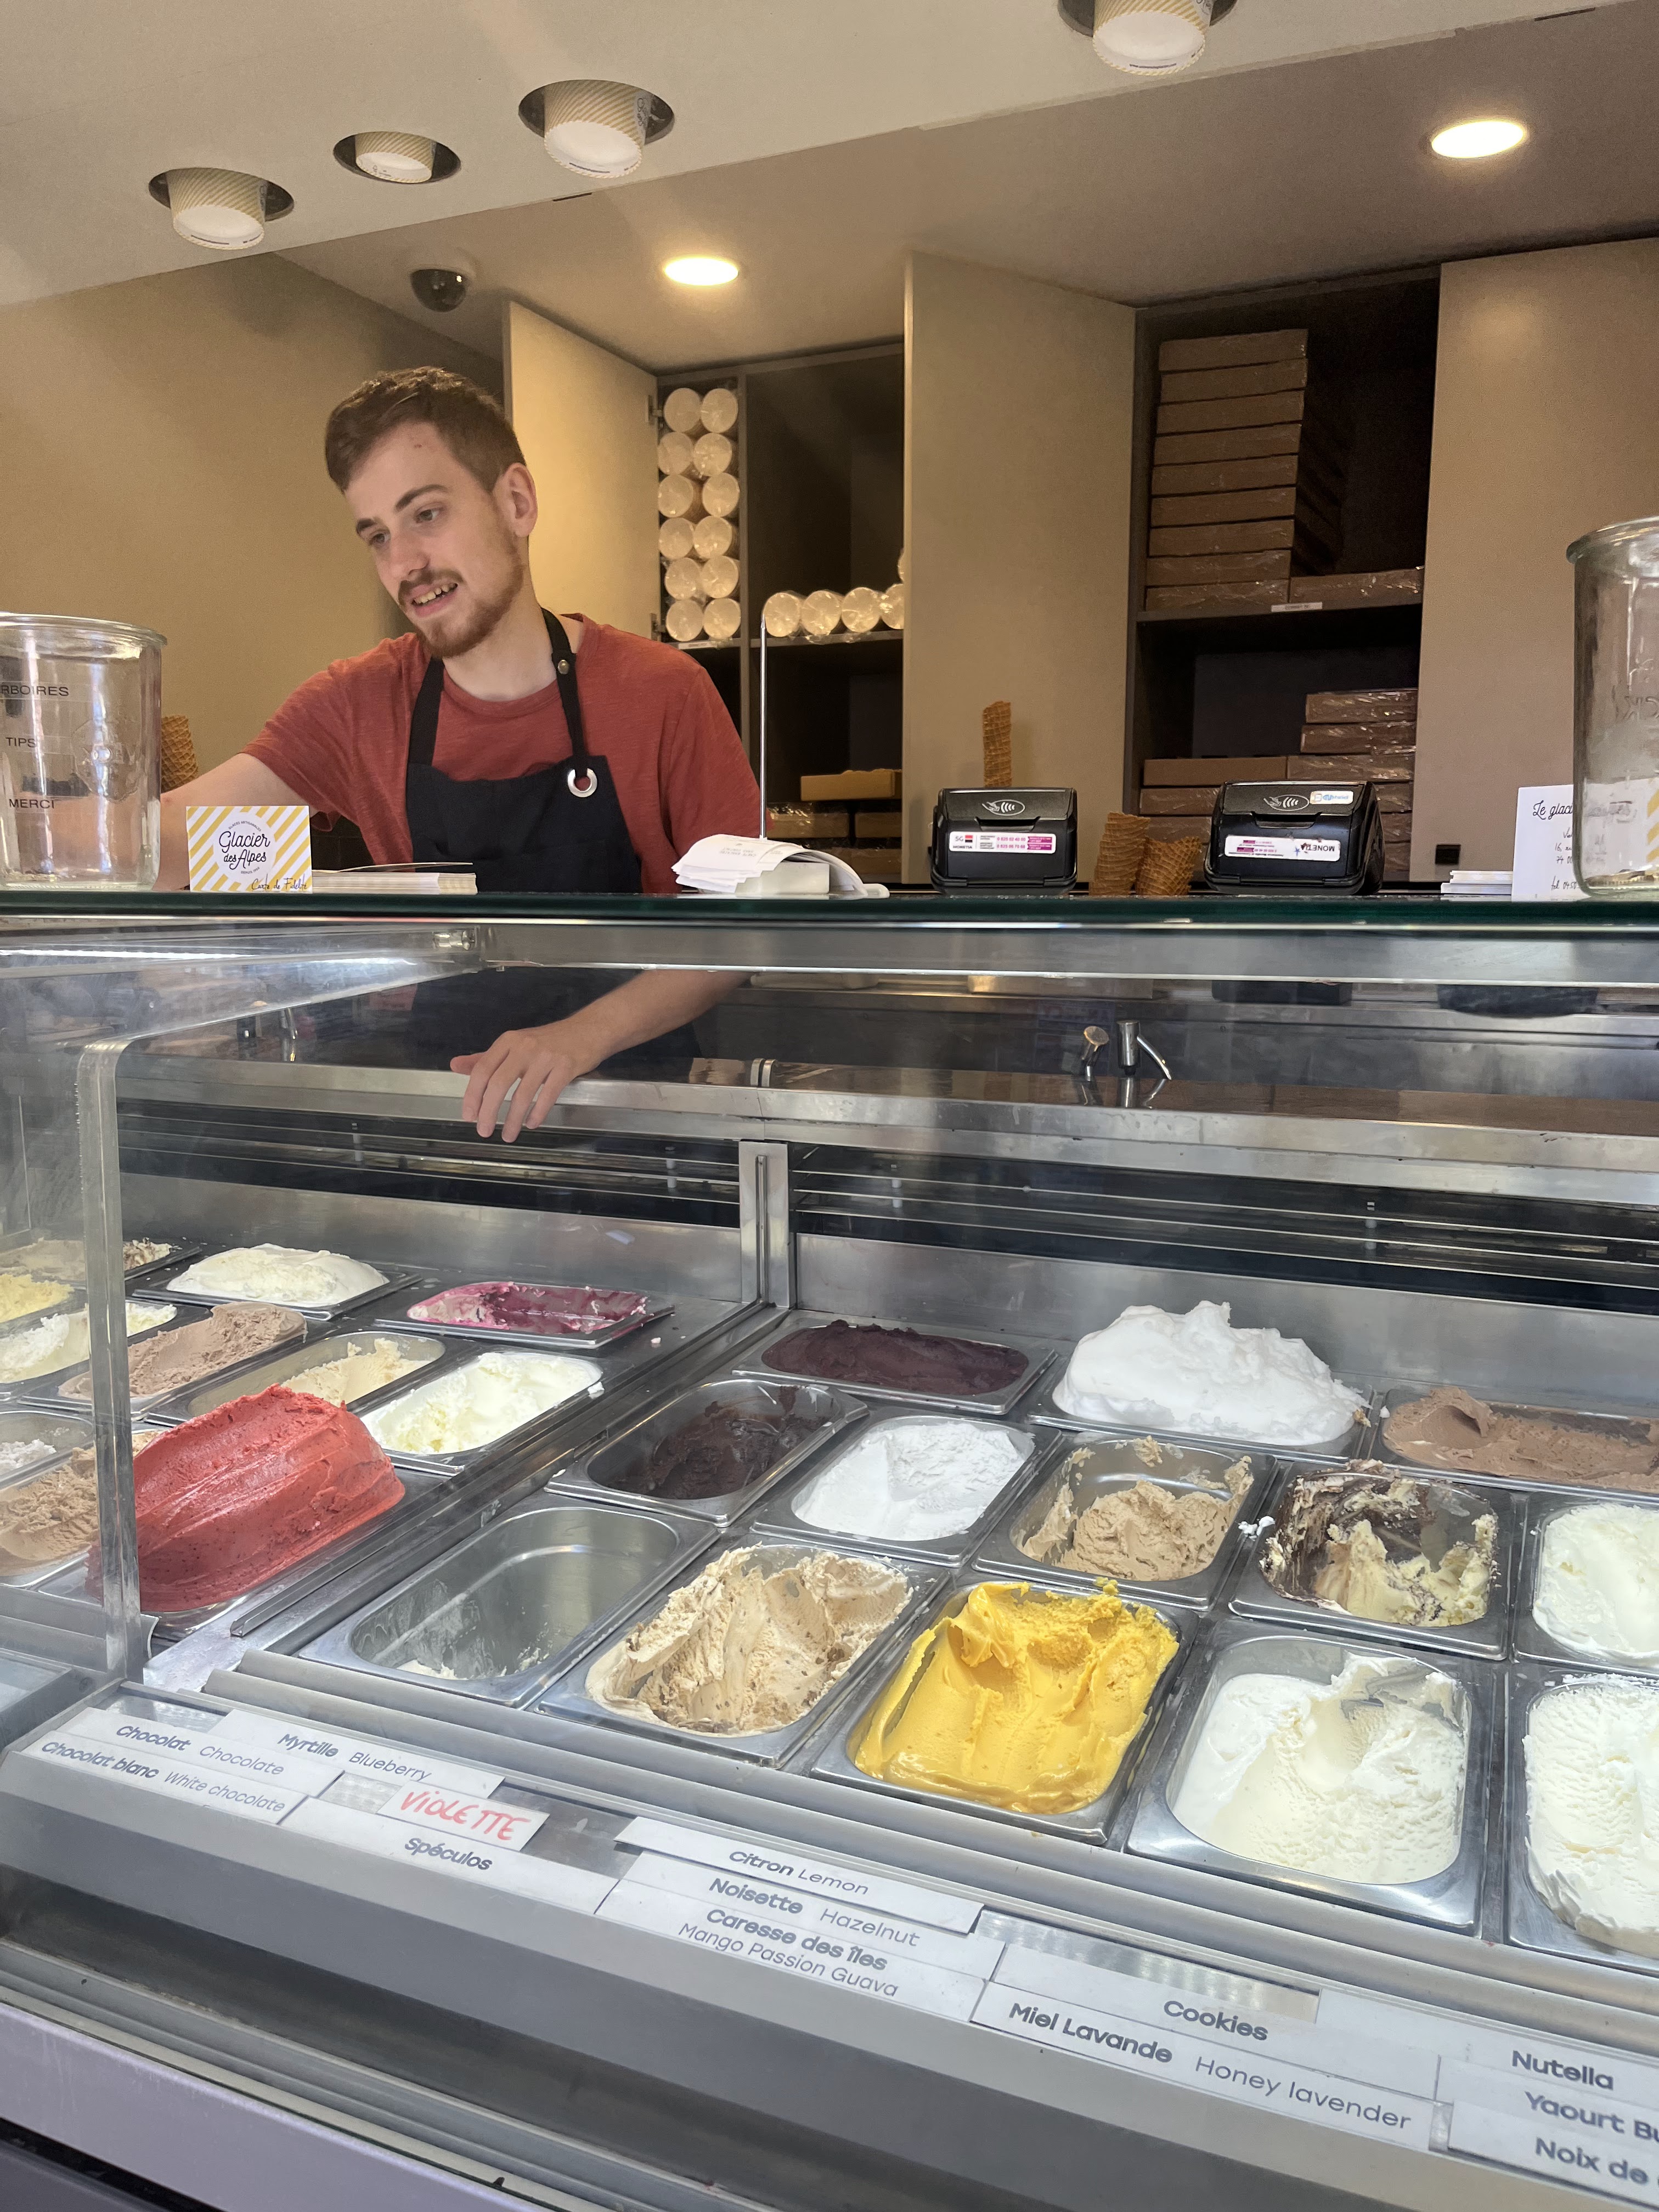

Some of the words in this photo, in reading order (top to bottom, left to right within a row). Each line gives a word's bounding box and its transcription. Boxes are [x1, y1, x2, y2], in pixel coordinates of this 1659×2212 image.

[1, 685, 70, 697] RBOIRES
[5, 737, 38, 748] TIPS
[9, 798, 55, 809] MERCI
[1532, 800, 1547, 820] Le
[1548, 803, 1573, 820] glaci
[219, 831, 270, 853] Glacier
[224, 854, 237, 862] des
[229, 849, 267, 870] Alpes
[274, 879, 280, 889] de
[116, 1725, 192, 1751] Chocolat
[199, 1746, 284, 1775] Chocolate
[278, 1733, 338, 1757] Myrtille
[348, 1752, 432, 1781] Blueberry
[42, 1741, 115, 1767] Chocolat
[111, 1758, 159, 1779] blanc
[165, 1771, 207, 1792] White
[208, 1785, 285, 1812] chocolate
[404, 1837, 493, 1871] Spéculos
[729, 1850, 794, 1877] Citron
[797, 1867, 870, 1895] Lemon
[708, 1877, 804, 1915] Noisette
[820, 1908, 921, 1948] Hazelnut
[678, 1923, 744, 1954] Mango
[747, 1943, 825, 1977] Passion
[831, 1967, 899, 1997] Guava
[707, 1909, 796, 1944] Caresse
[802, 1936, 844, 1960] des
[846, 1945, 888, 1971] îles
[1164, 2000, 1269, 2041] Cookies
[1008, 2002, 1059, 2031] Miel
[1062, 2017, 1173, 2064] Lavande
[1195, 2056, 1281, 2097] Honey
[1289, 2080, 1412, 2130] lavender
[1511, 2050, 1614, 2091] Nutella
[1524, 2090, 1625, 2134] Yaourt
[1535, 2136, 1601, 2173] Noix
[1609, 2159, 1649, 2186] de
